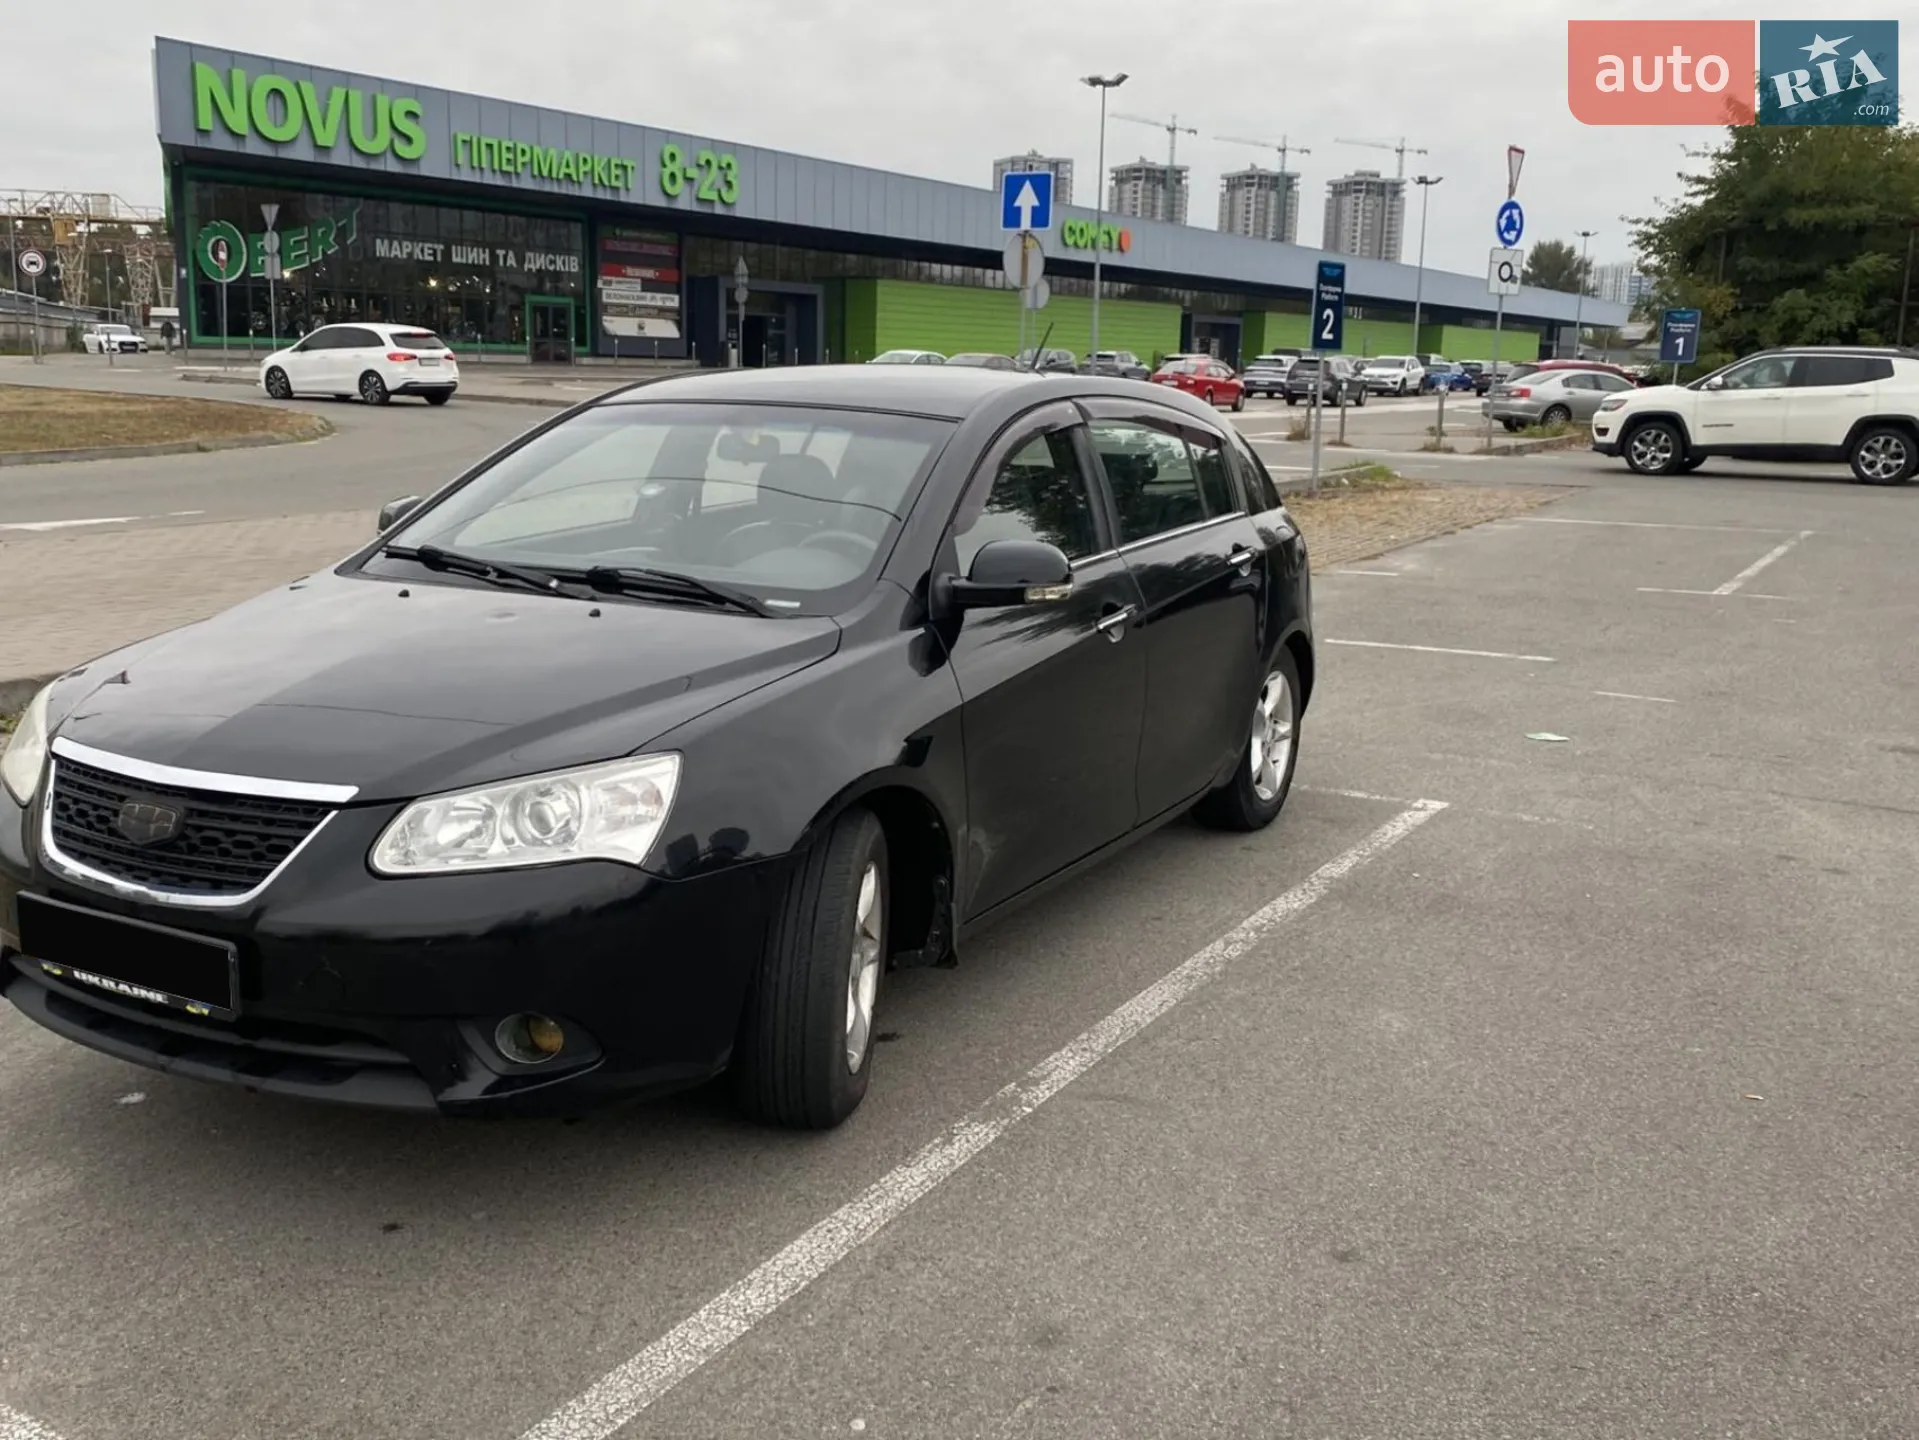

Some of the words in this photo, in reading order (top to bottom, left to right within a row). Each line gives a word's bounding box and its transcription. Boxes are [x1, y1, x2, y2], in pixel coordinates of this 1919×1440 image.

[193, 61, 427, 160] NOVUS
[453, 131, 637, 191] ГІПЕРМАРКЕТ
[660, 143, 739, 204] 8-23
[375, 238, 444, 262] МАРКЕТ
[452, 245, 490, 266] ШИН
[496, 249, 517, 268] ТА
[524, 251, 579, 273] ДИСКІВ
[1321, 308, 1334, 340] 2
[1675, 336, 1685, 356] 1
[72, 969, 169, 1004] UKRAINE
